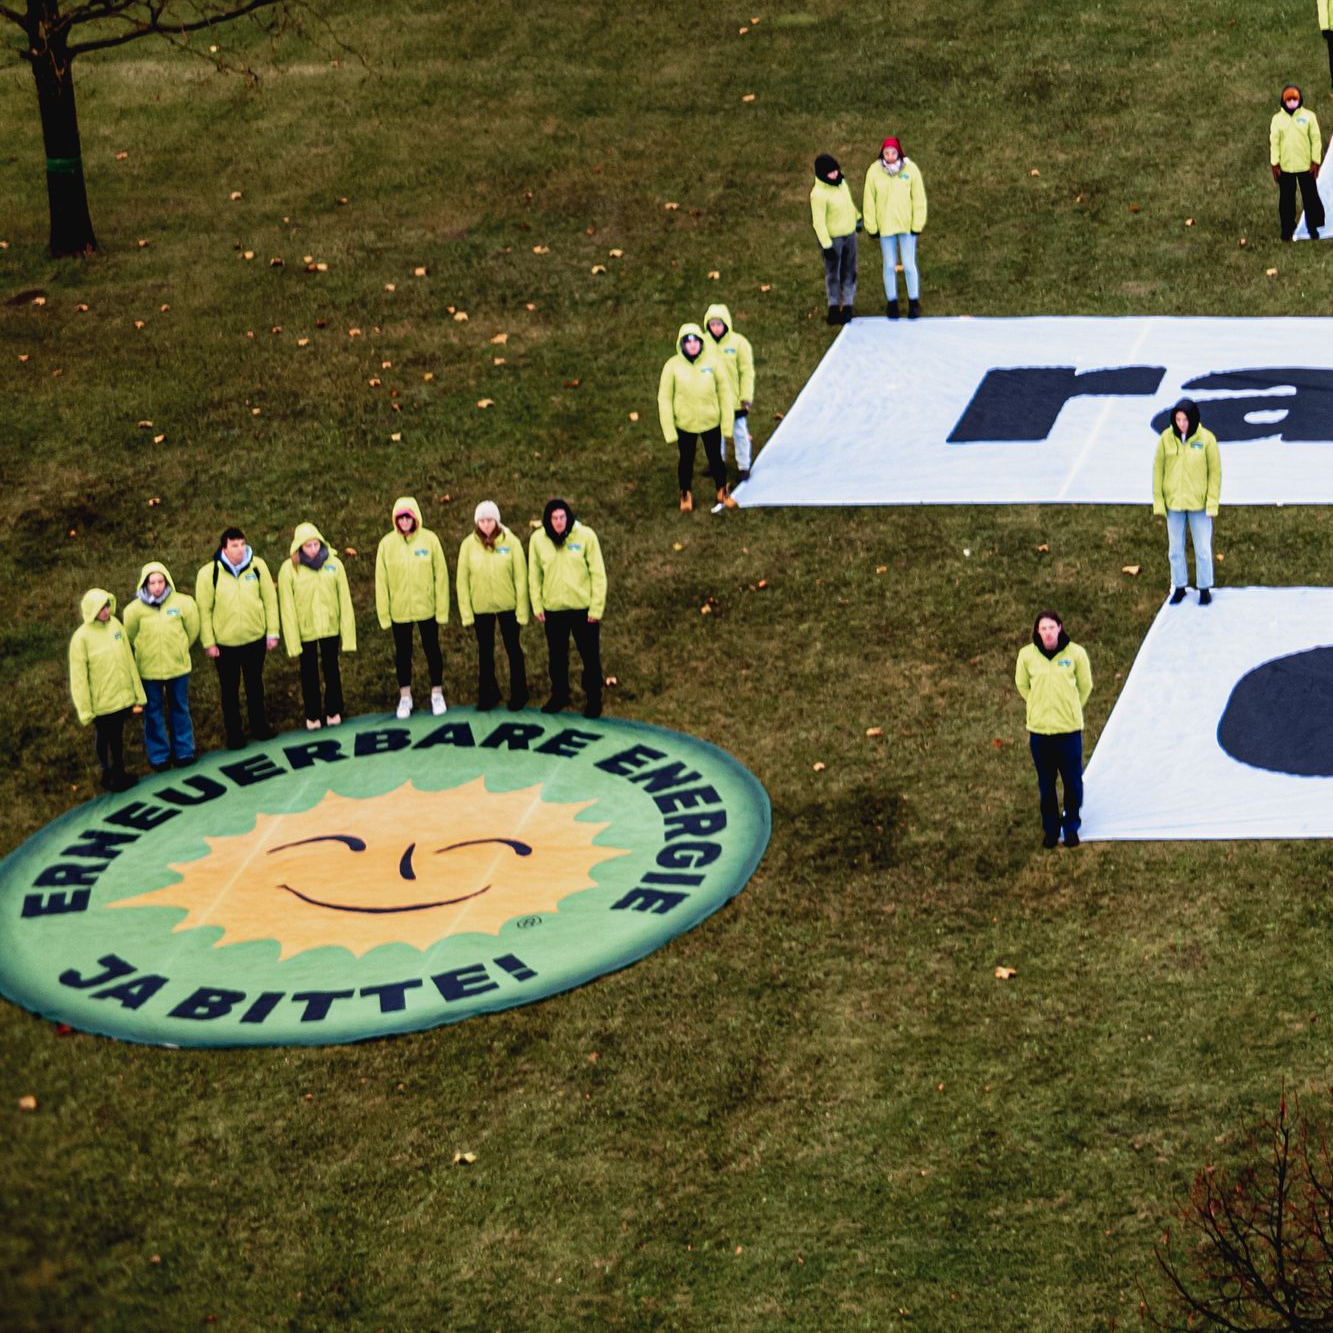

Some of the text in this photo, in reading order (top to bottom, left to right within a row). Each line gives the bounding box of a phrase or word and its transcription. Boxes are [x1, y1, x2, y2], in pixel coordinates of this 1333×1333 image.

[21, 721, 728, 919] ERNEUERBARE ENERGIE
[58, 953, 538, 1024] JA BITTE!
